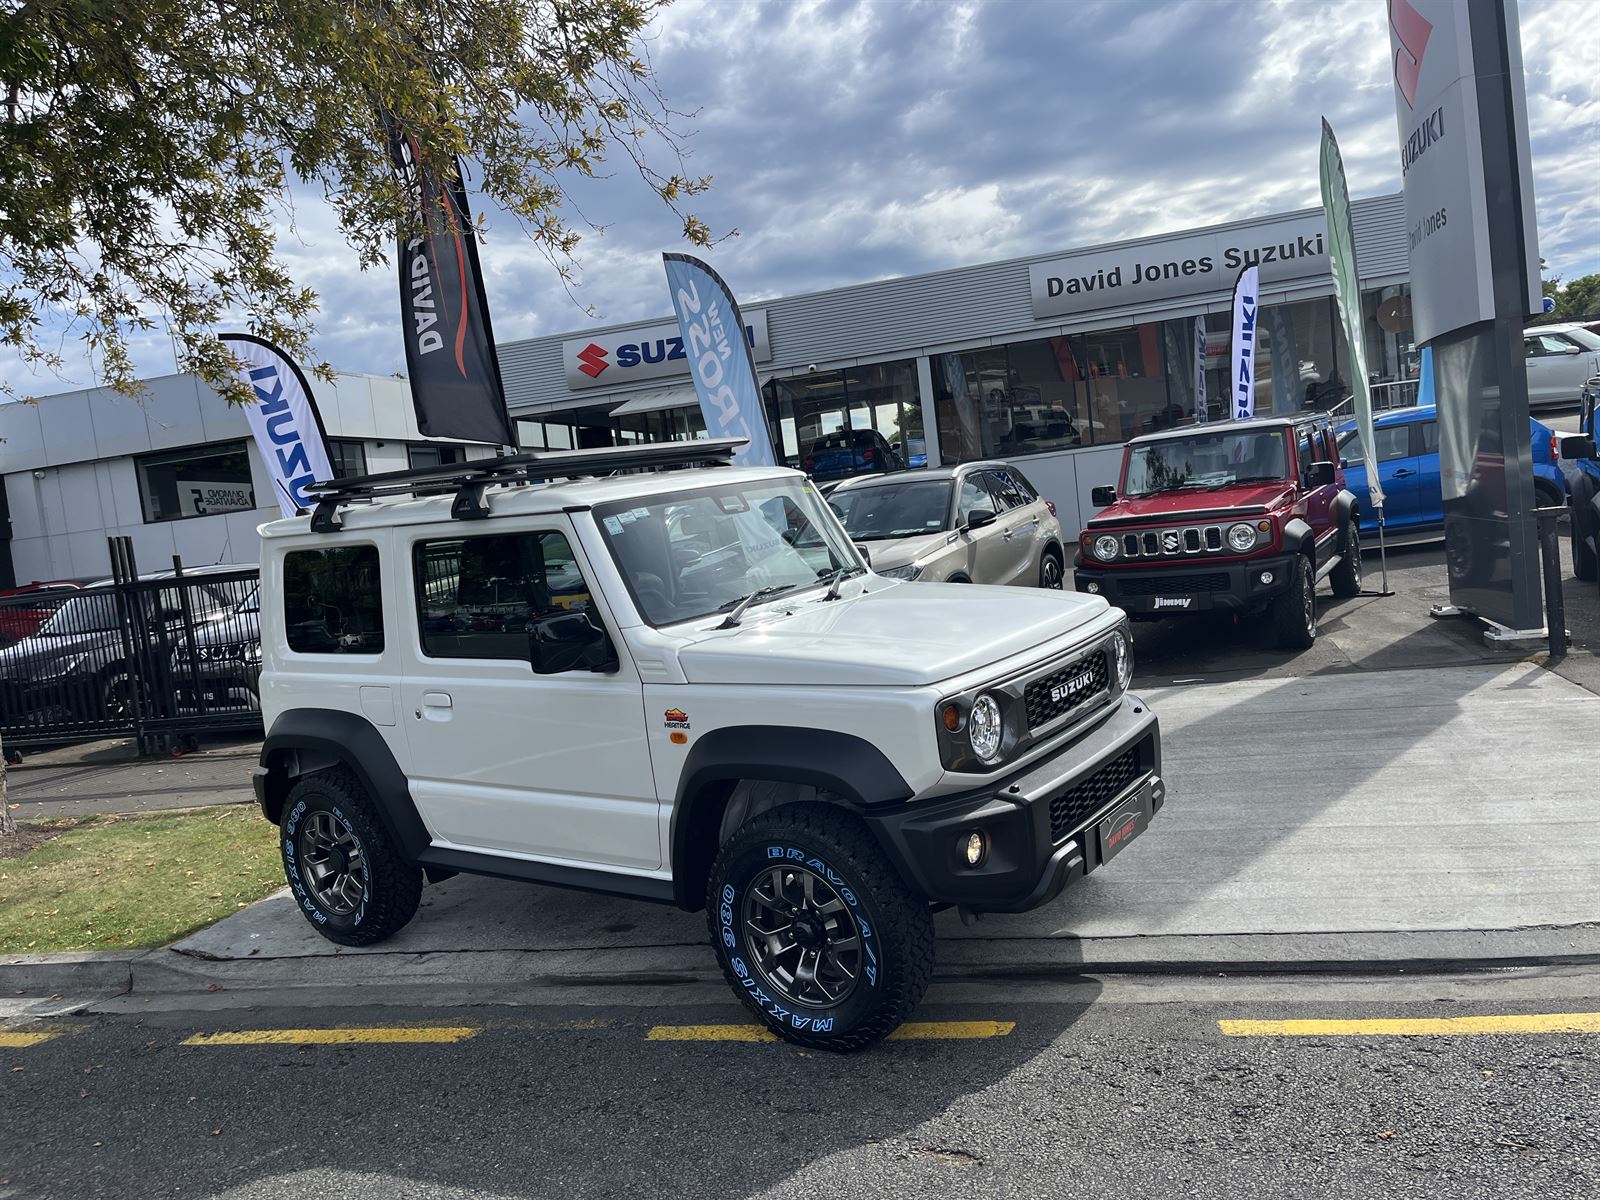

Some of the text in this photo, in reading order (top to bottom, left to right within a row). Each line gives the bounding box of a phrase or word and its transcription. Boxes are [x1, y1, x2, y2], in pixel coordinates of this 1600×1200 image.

[1047, 233, 1324, 297] David Jones Suzuki
[616, 326, 755, 368] SUZI
[1051, 671, 1094, 702] SUZUKI
[285, 839, 328, 925] MAXXIS
[767, 846, 877, 987] BRAVO A/T
[720, 884, 834, 1032] MAXXIS 980
